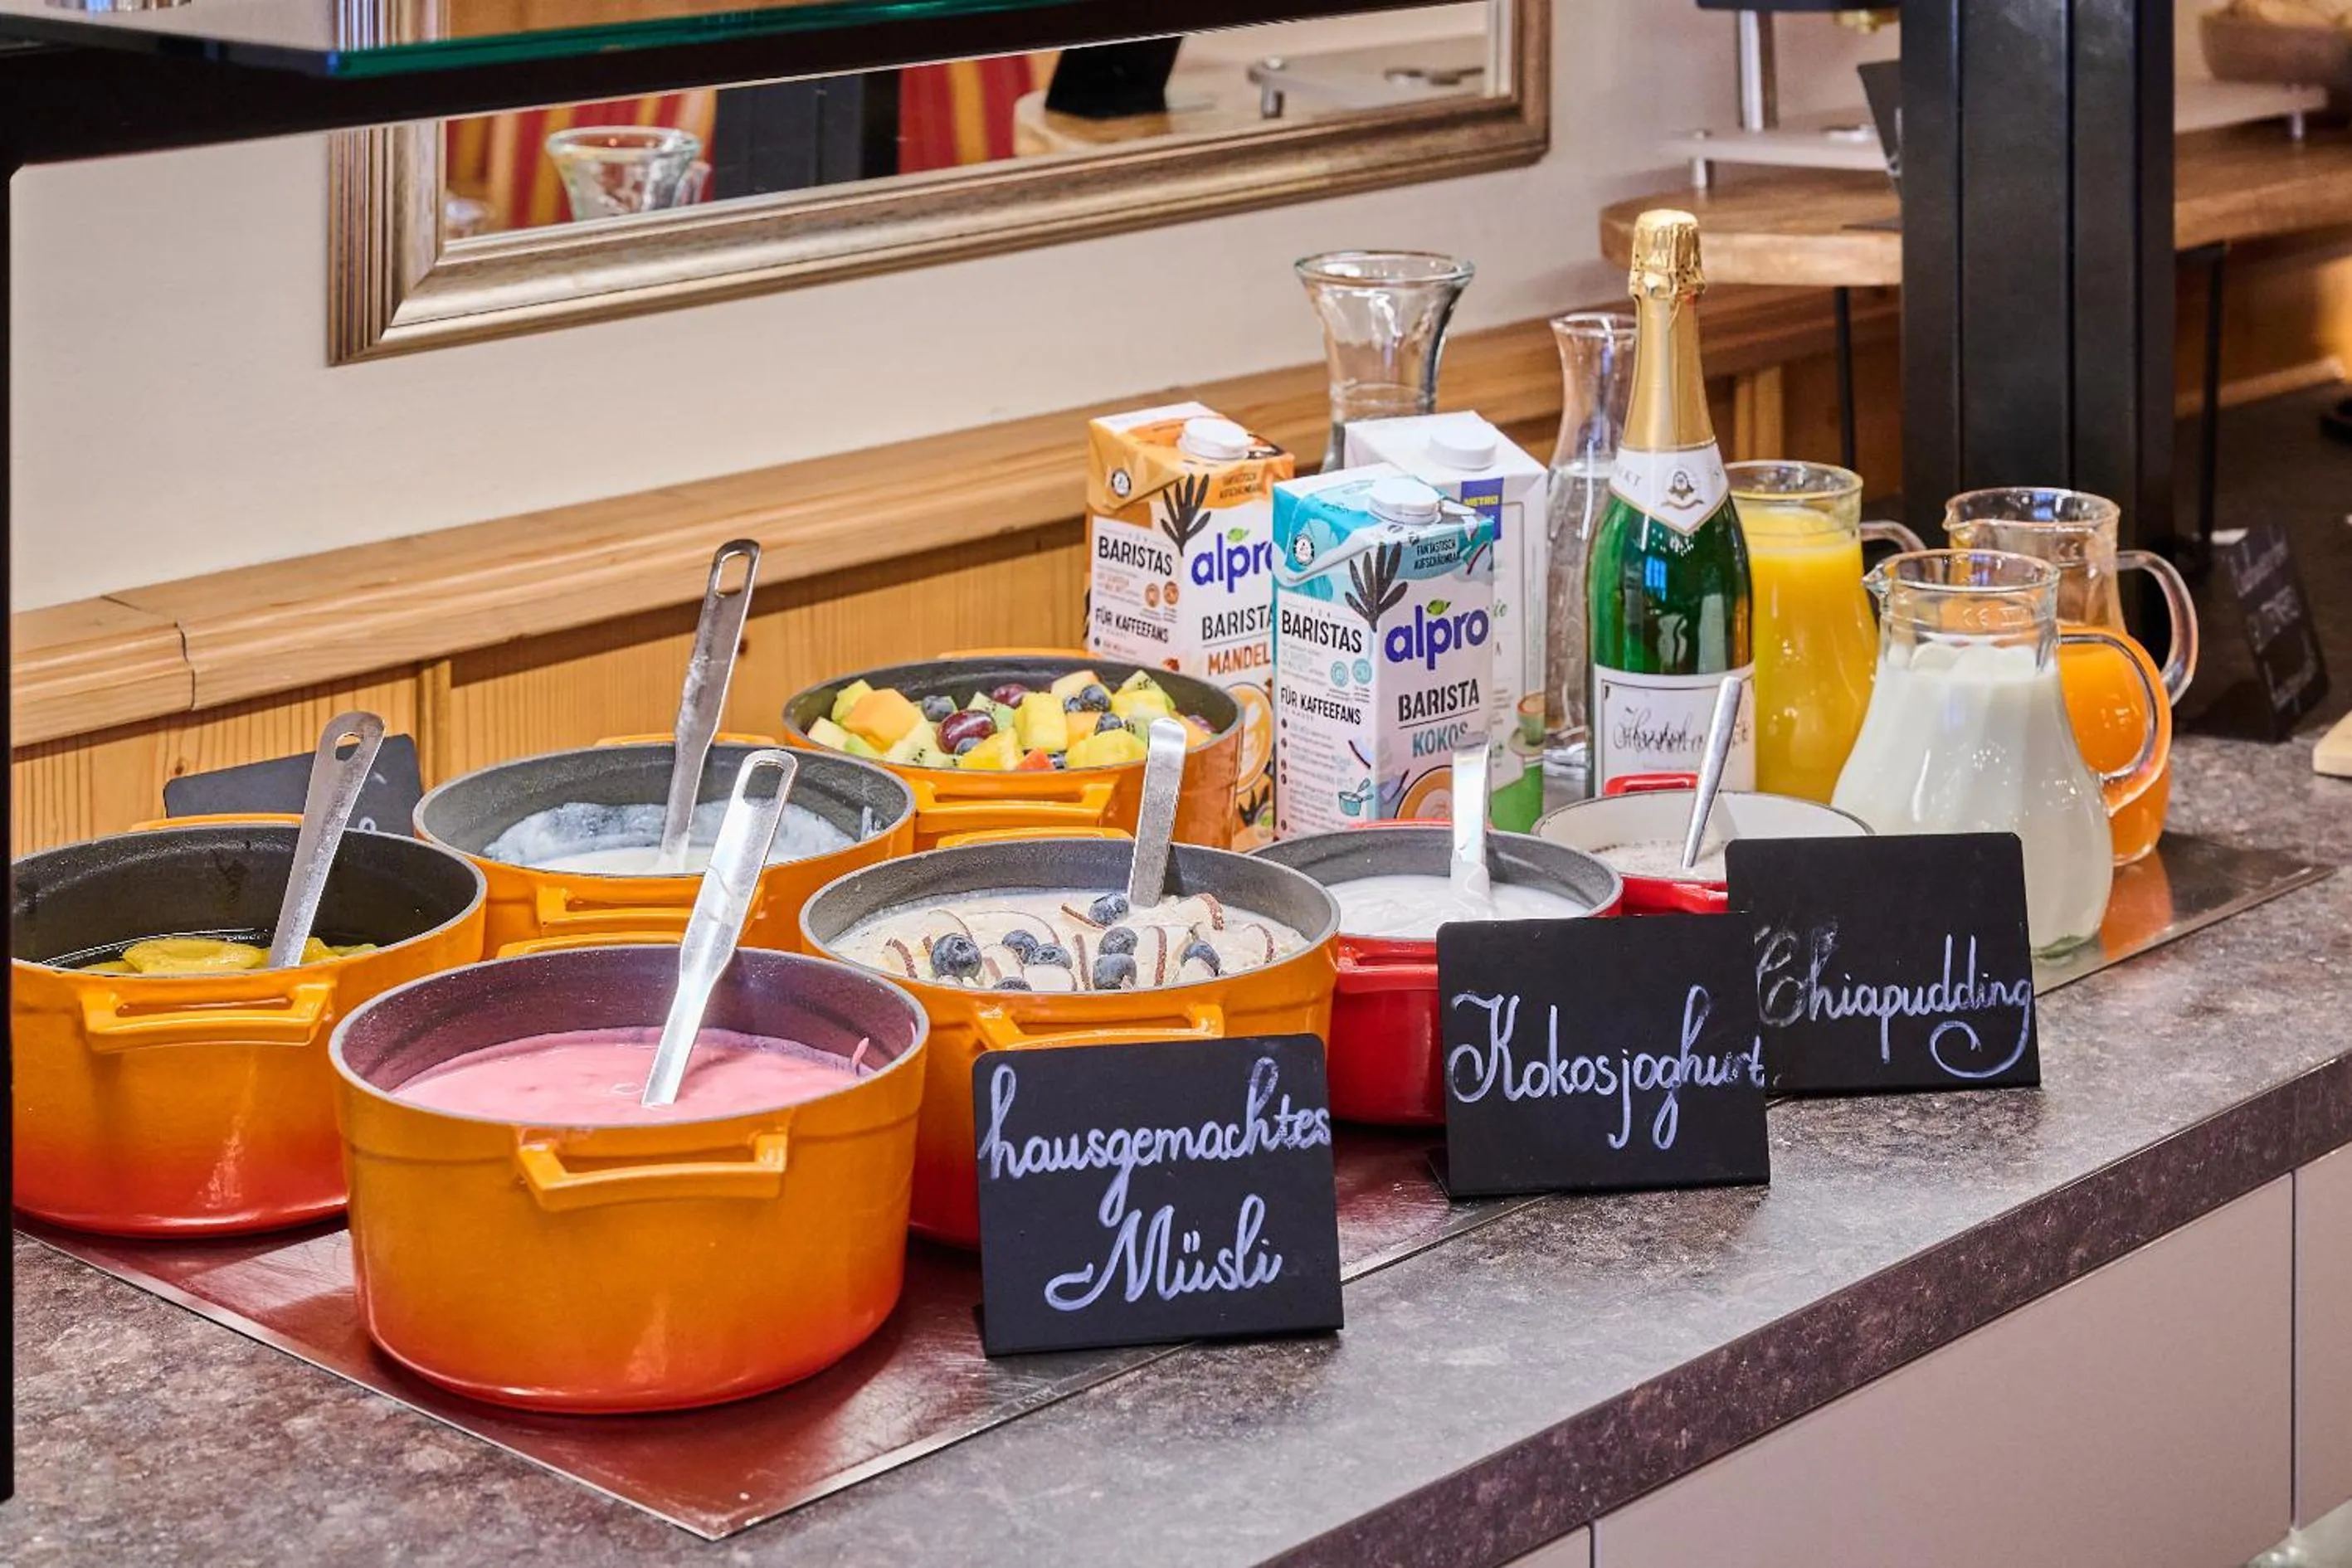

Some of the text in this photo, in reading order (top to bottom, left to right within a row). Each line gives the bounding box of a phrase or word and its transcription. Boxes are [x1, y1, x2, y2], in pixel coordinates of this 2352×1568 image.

[1098, 535, 1173, 577] BARISTAS
[1115, 614, 1169, 644] KAFFEEFANS
[1282, 609, 1362, 654] BARISTAS
[1385, 604, 1489, 671] alpro
[1207, 640, 1272, 677] MANDEL
[1281, 685, 1298, 708] FÜR
[1300, 694, 1361, 726] KAFFEEFANS
[1398, 678, 1480, 722] BARISTA
[1448, 984, 1765, 1151] Kokosjoghurt
[977, 1056, 1332, 1228] hausgemachtes
[1044, 1193, 1283, 1312] Müsli
